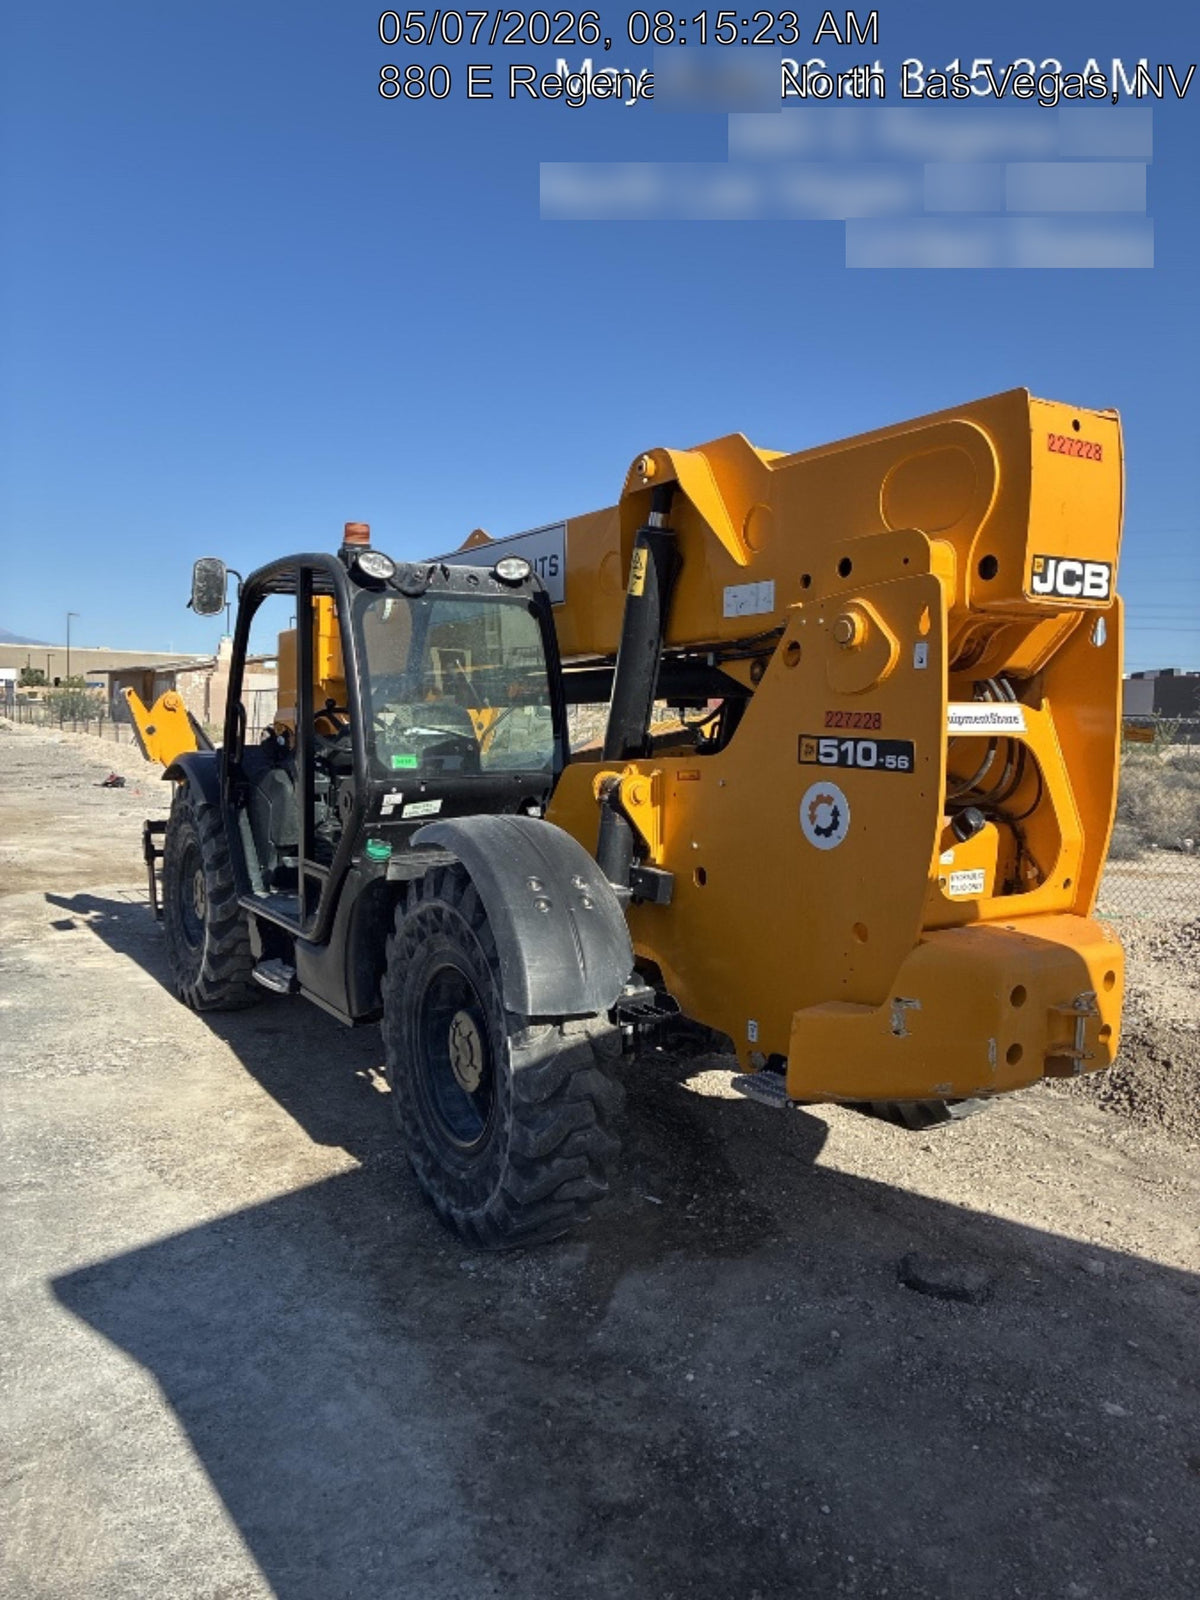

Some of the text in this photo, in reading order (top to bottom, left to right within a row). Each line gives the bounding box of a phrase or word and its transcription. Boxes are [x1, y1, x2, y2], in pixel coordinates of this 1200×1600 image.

[1048, 432, 1102, 461] 227228
[1032, 560, 1110, 598] JCB
[825, 711, 881, 729] 227228
[948, 712, 1019, 726] uipmentShare
